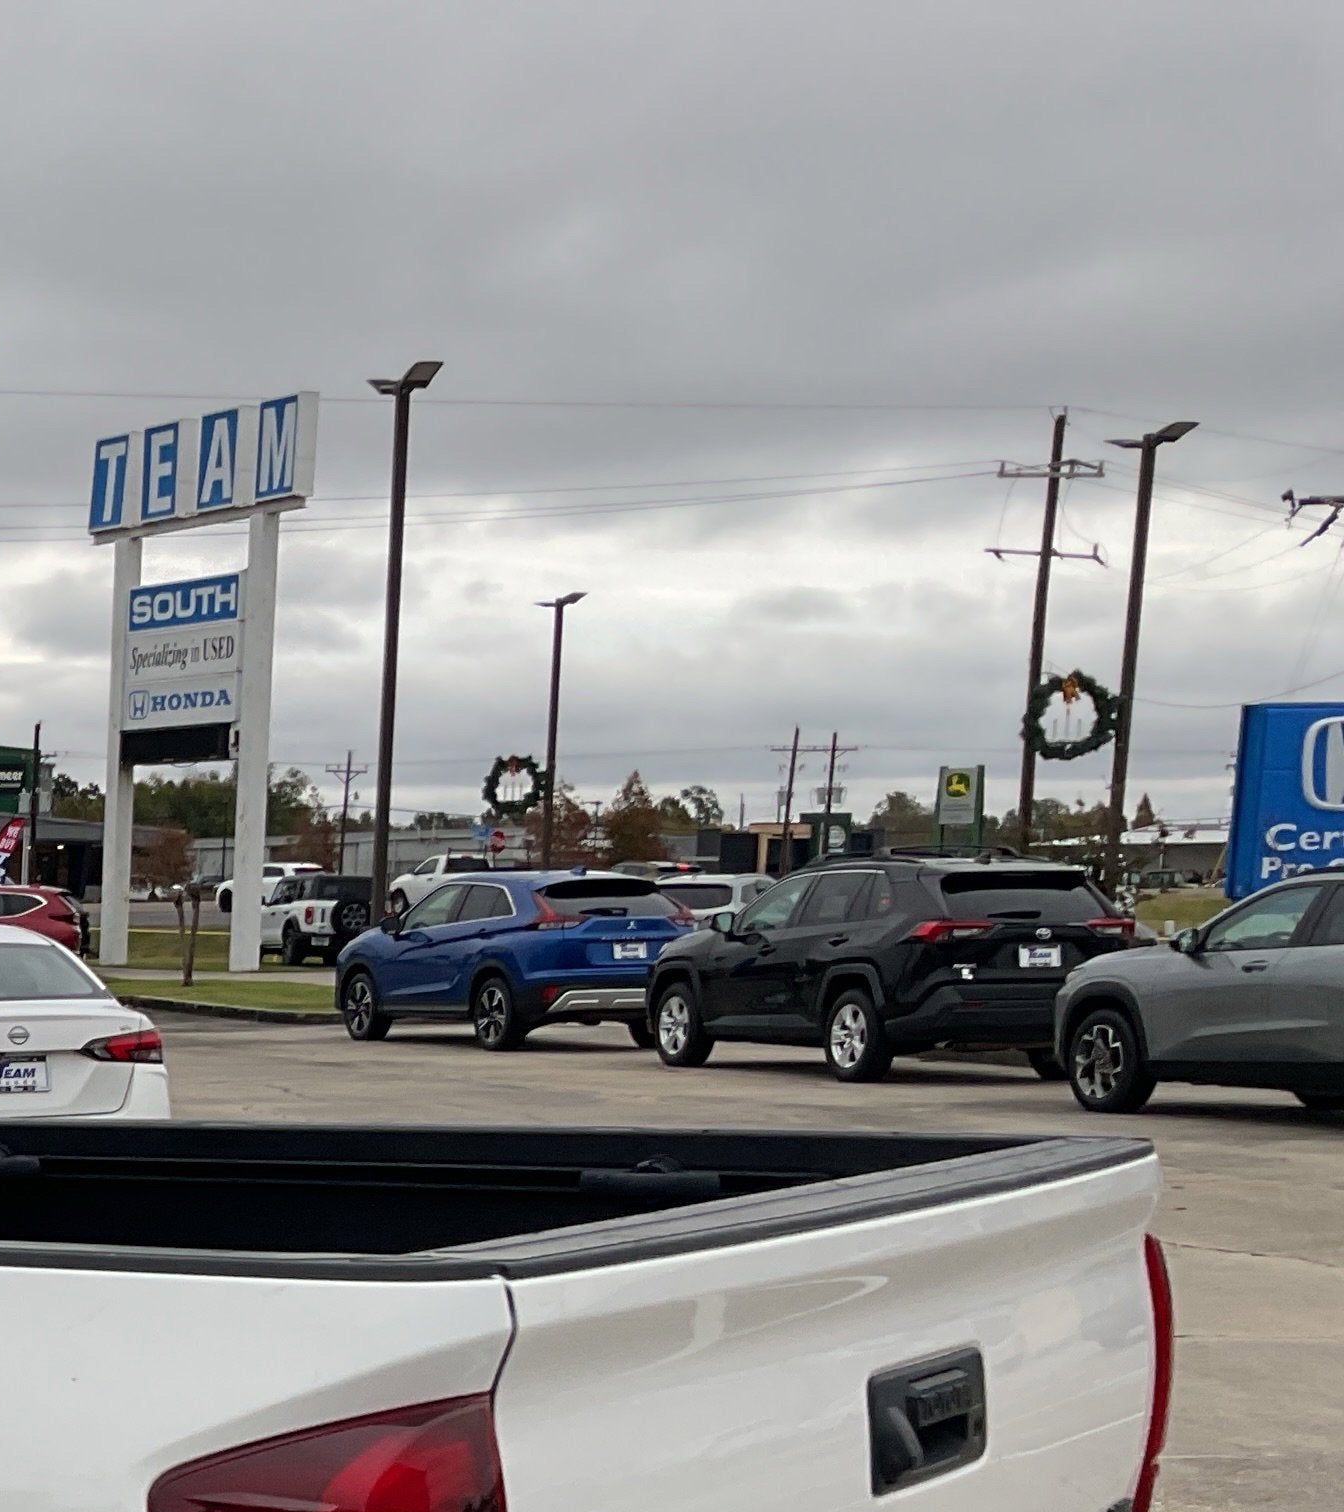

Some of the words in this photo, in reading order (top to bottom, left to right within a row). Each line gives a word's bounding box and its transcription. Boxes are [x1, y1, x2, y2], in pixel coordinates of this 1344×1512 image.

[100, 403, 298, 523] TEAM
[132, 582, 236, 624] SOUTH
[130, 643, 188, 676] Specializing
[190, 640, 200, 662] in
[203, 635, 234, 661] USED
[151, 689, 232, 712] HONDA
[1264, 823, 1344, 851] Cer
